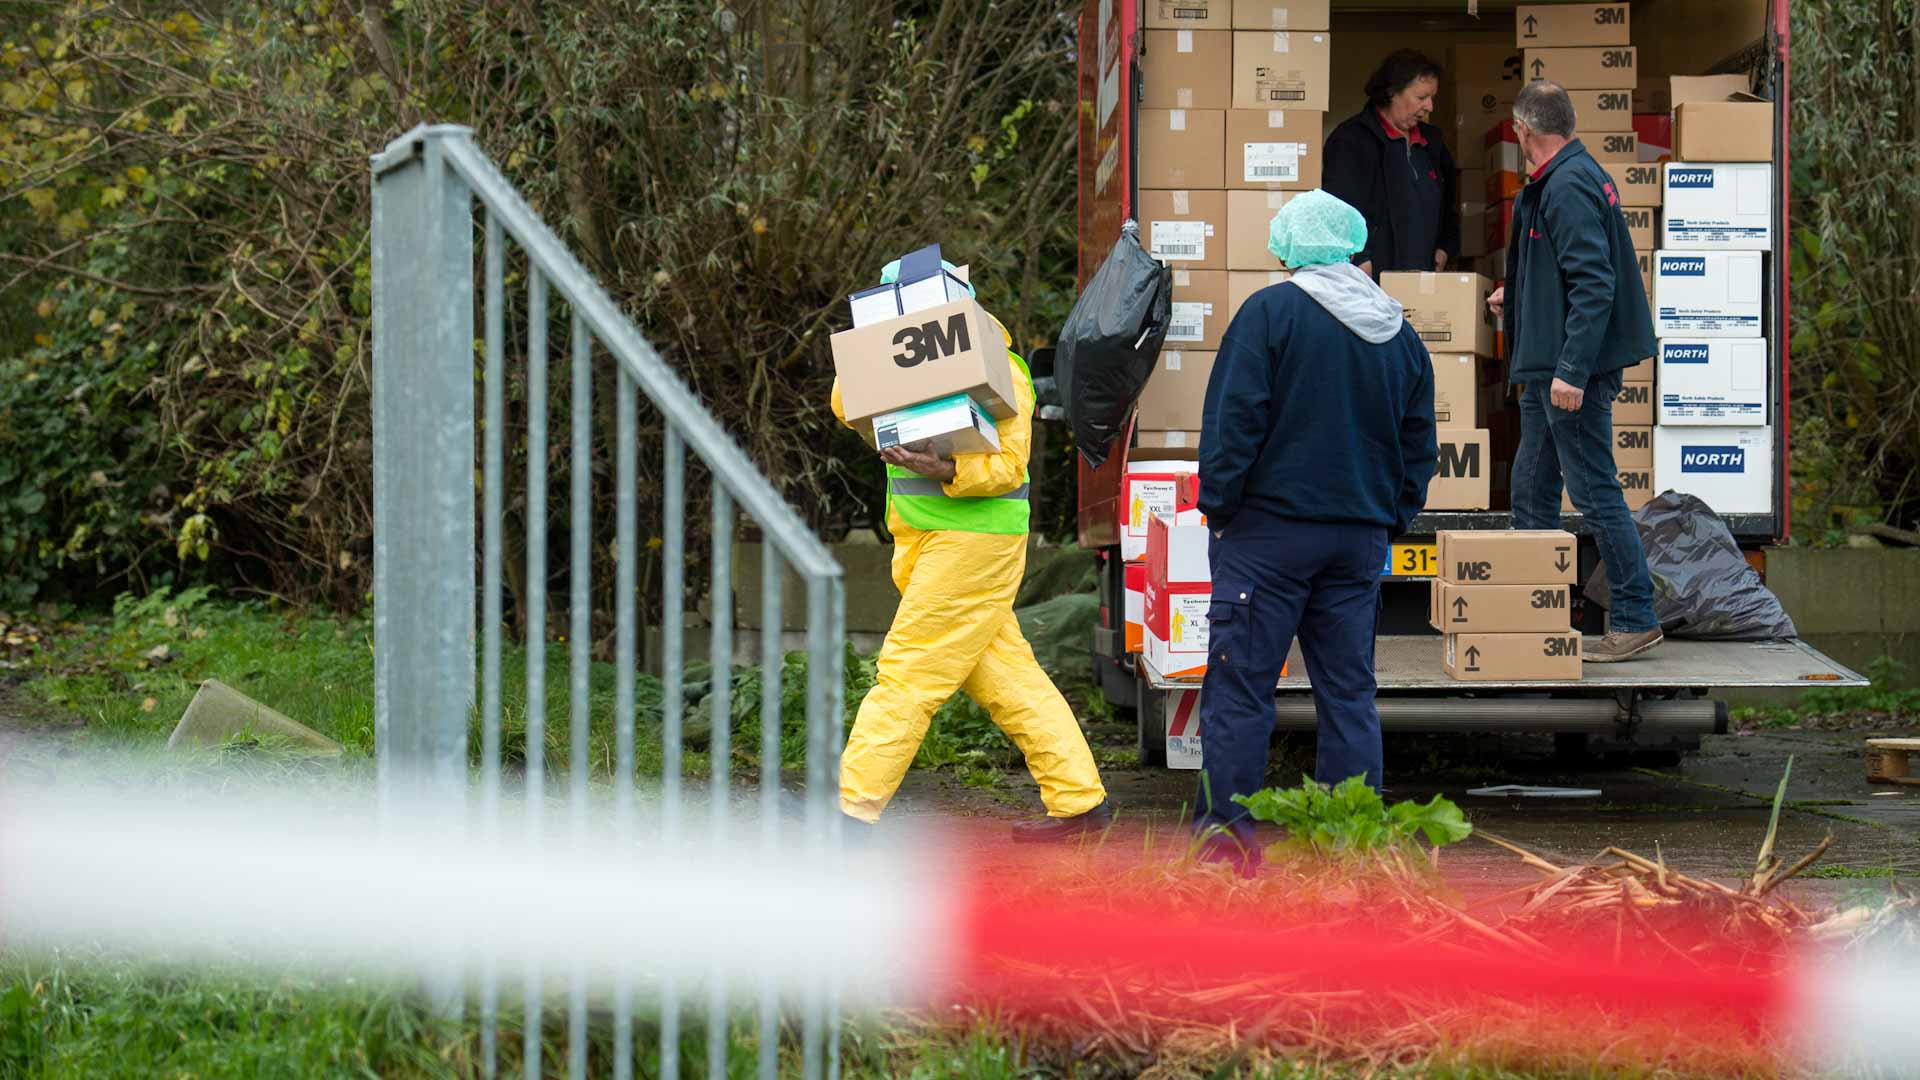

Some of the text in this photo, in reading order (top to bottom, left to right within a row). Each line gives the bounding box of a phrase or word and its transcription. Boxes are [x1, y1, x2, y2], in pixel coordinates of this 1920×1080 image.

[1594, 7, 1625, 25] 3M
[1601, 51, 1633, 68] 3M
[1597, 93, 1629, 111] 3M
[1603, 136, 1634, 153] 3M
[1625, 167, 1657, 185] 3M
[1669, 173, 1712, 183] NORTH
[1661, 261, 1704, 271] NORTH
[892, 312, 972, 368] 3M
[1664, 349, 1708, 359] NORTH
[1617, 387, 1648, 404] 3M
[1618, 431, 1649, 448] 3M
[1437, 443, 1480, 477] M
[1683, 453, 1743, 465] NORTH
[1618, 472, 1649, 489] 3M
[1149, 505, 1162, 513] XXL
[1456, 561, 1492, 581] 3M
[1530, 590, 1565, 609] 3M
[1543, 637, 1578, 656] 3M
